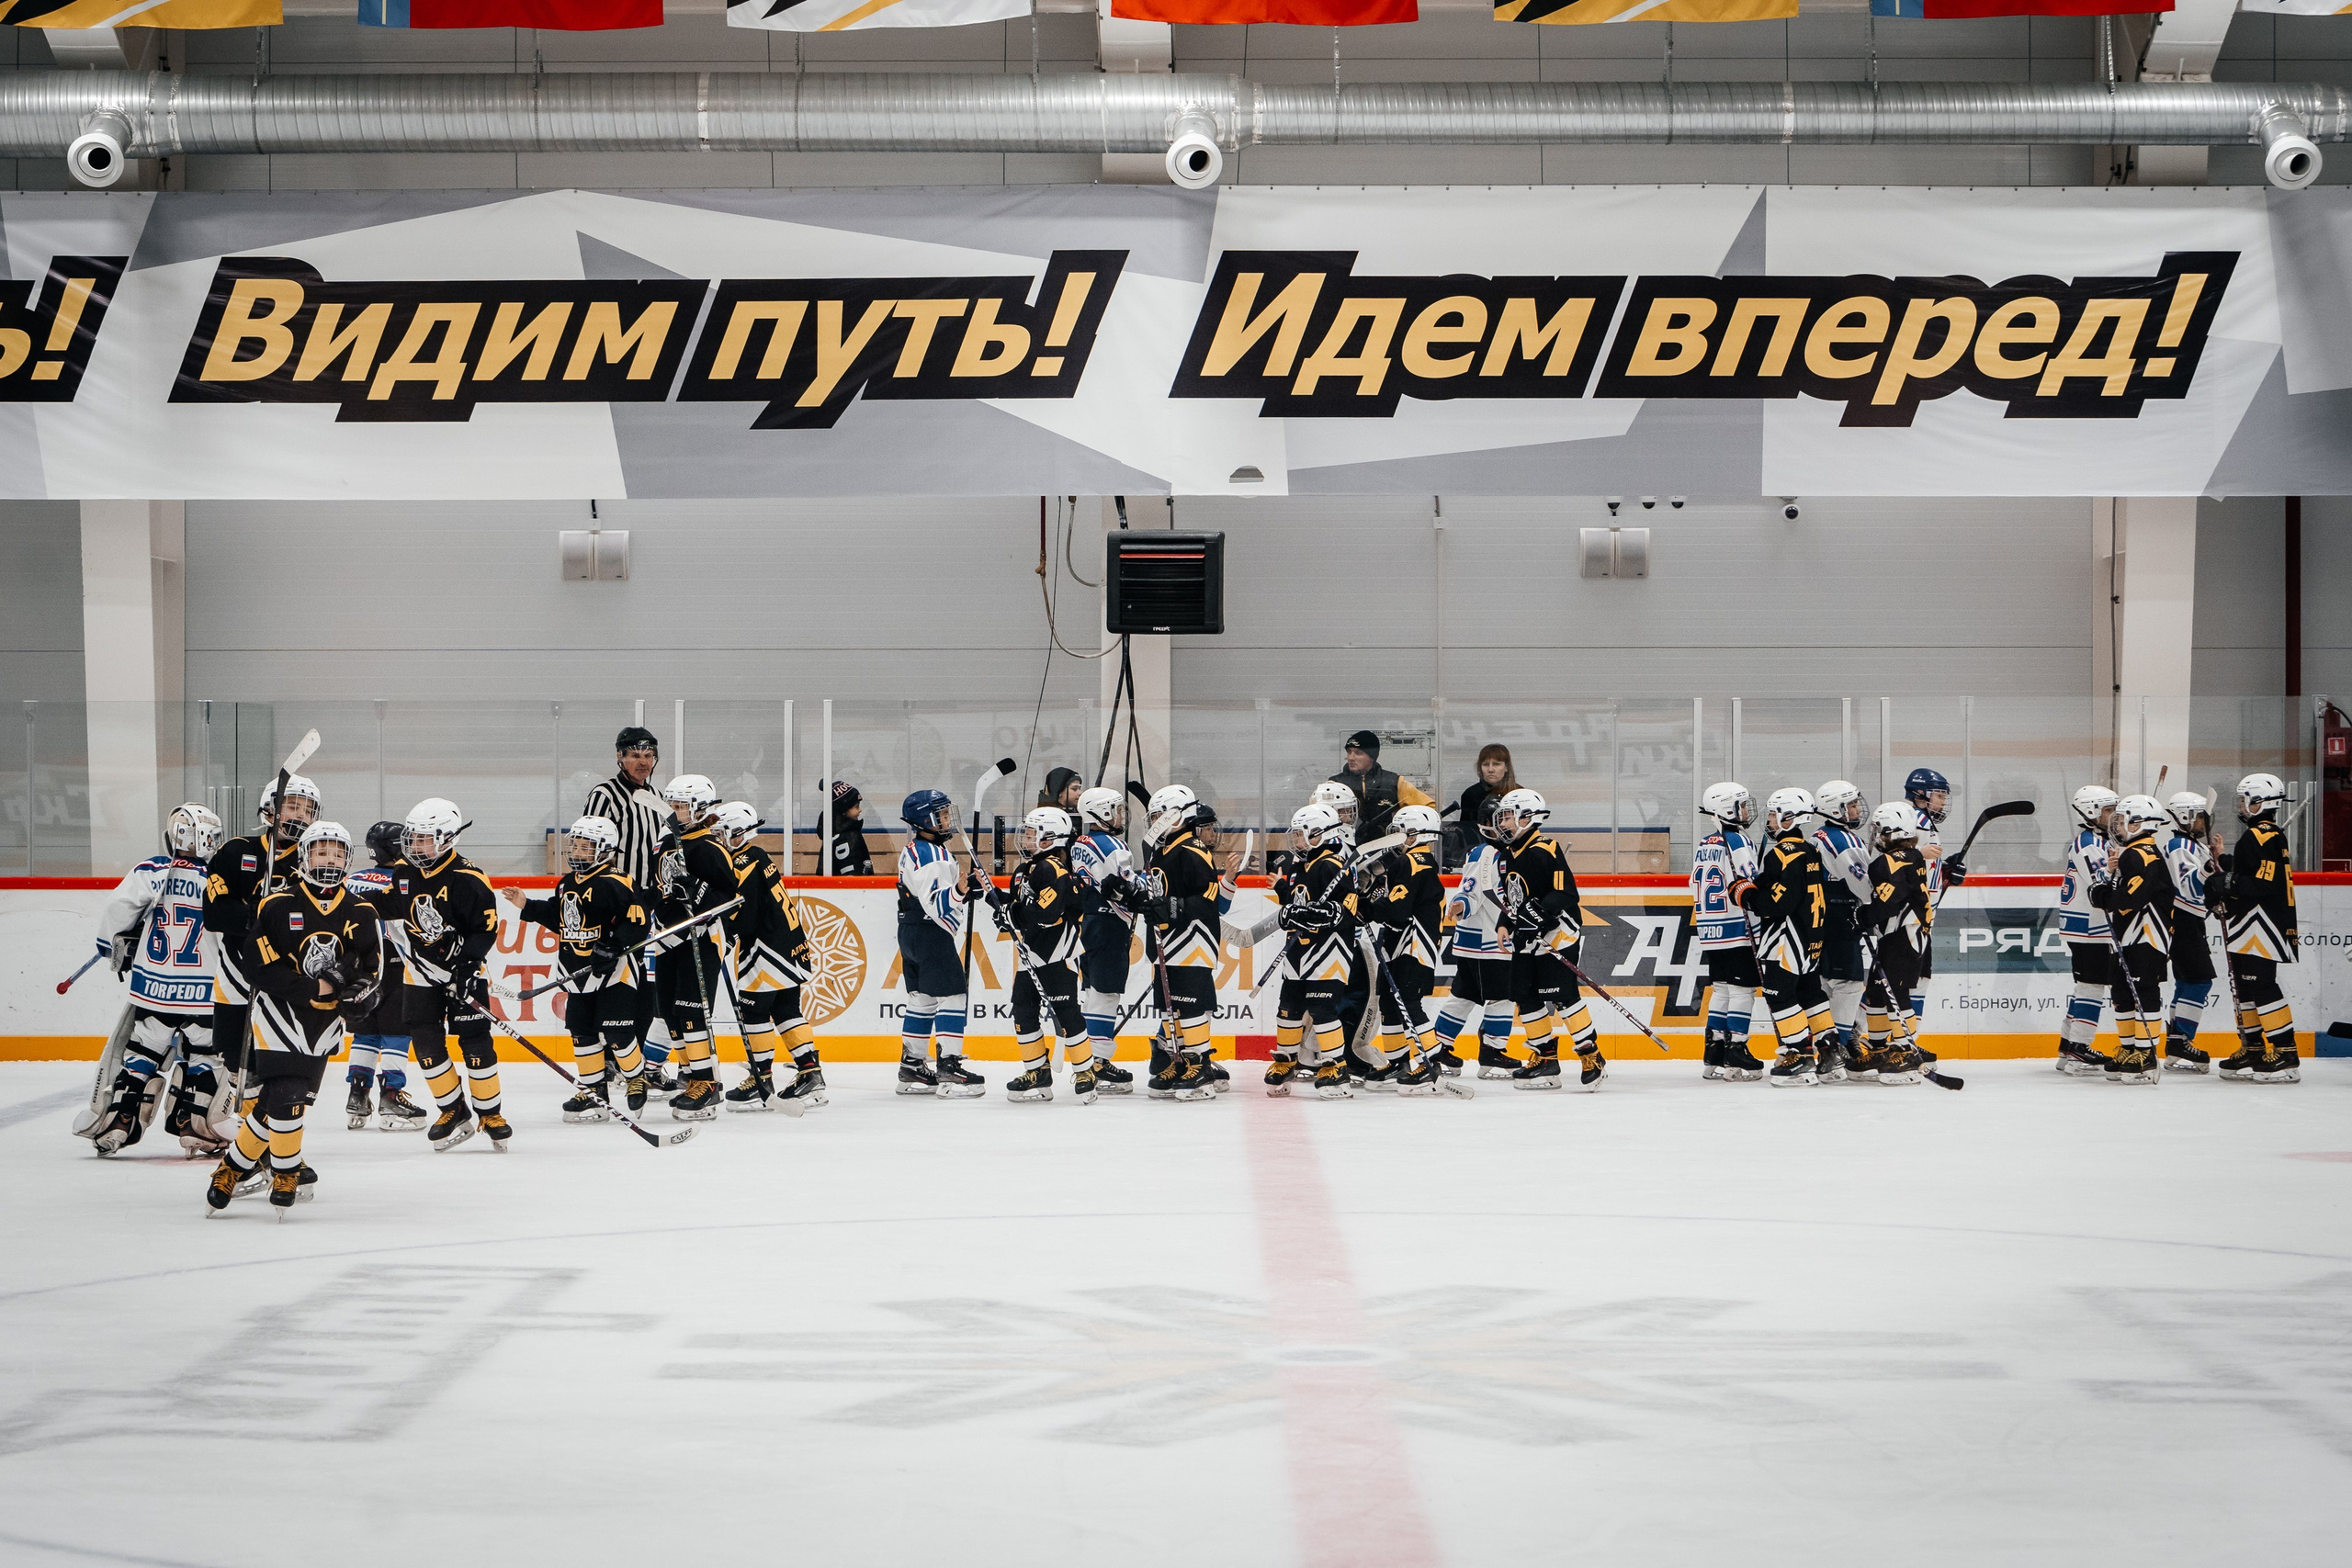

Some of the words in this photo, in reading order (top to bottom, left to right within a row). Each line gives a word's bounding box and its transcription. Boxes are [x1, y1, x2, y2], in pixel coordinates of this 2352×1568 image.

[200, 279, 678, 400] Видим
[709, 273, 1095, 406] путь!
[1201, 273, 1595, 395] Идем
[1626, 274, 2208, 404] вперед!
[435, 886, 448, 902] A
[582, 886, 594, 902] A
[770, 879, 800, 931] 2
[1692, 864, 1728, 914] 12
[146, 902, 204, 967] 67
[143, 978, 207, 1001] TORPEDO
[1941, 998, 1953, 1009] г.
[1959, 995, 2032, 1012] Барнаул,
[2037, 998, 2060, 1012] ул.
